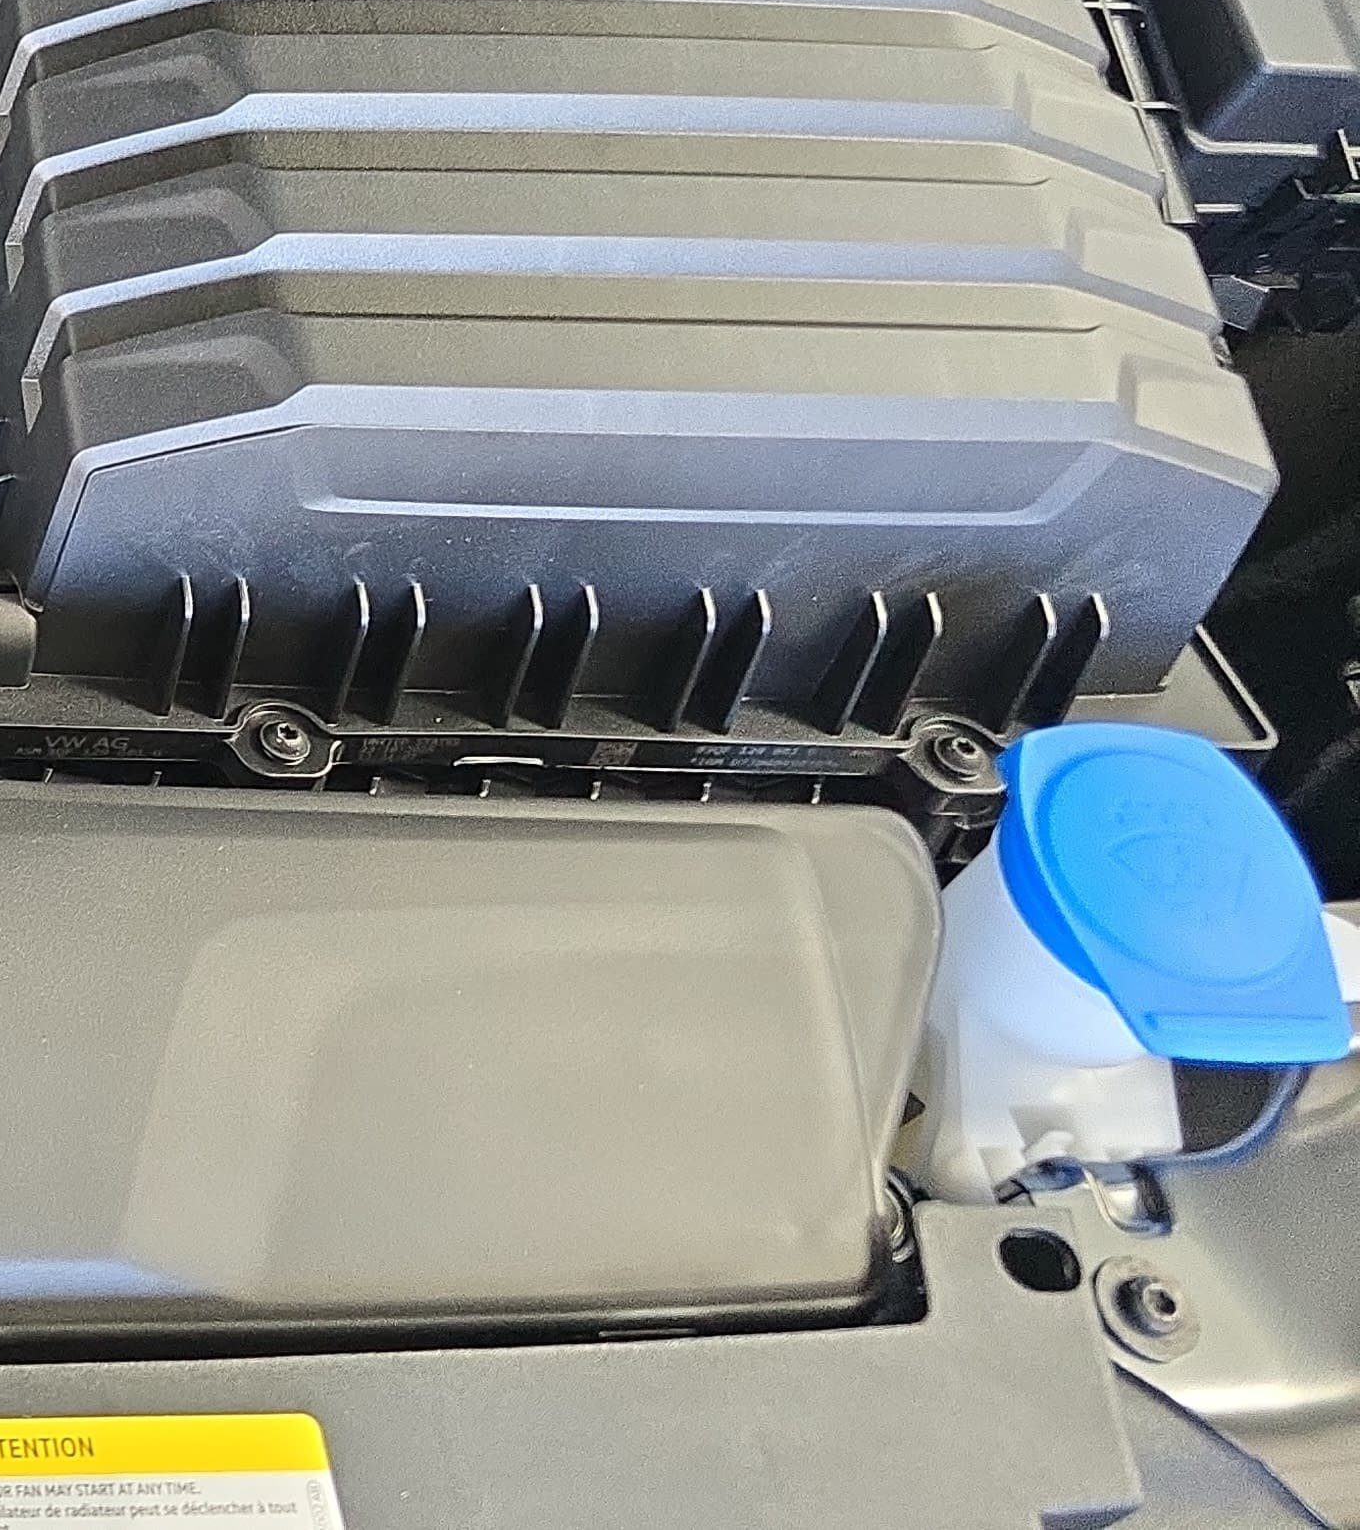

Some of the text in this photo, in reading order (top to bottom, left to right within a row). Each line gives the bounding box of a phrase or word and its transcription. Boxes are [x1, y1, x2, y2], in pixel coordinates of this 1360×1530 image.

[16, 1484, 42, 1498] FAN
[44, 1484, 72, 1497] MAY
[75, 1483, 114, 1497] START
[118, 1482, 136, 1496] AT
[137, 1482, 163, 1495] ANY
[45, 1505, 61, 1518] de
[65, 1504, 126, 1518] radiateur
[130, 1504, 159, 1519] peut
[164, 1506, 178, 1516] se
[182, 1501, 254, 1516] déclencher
[257, 1501, 265, 1513] à
[269, 1502, 297, 1514] tout
